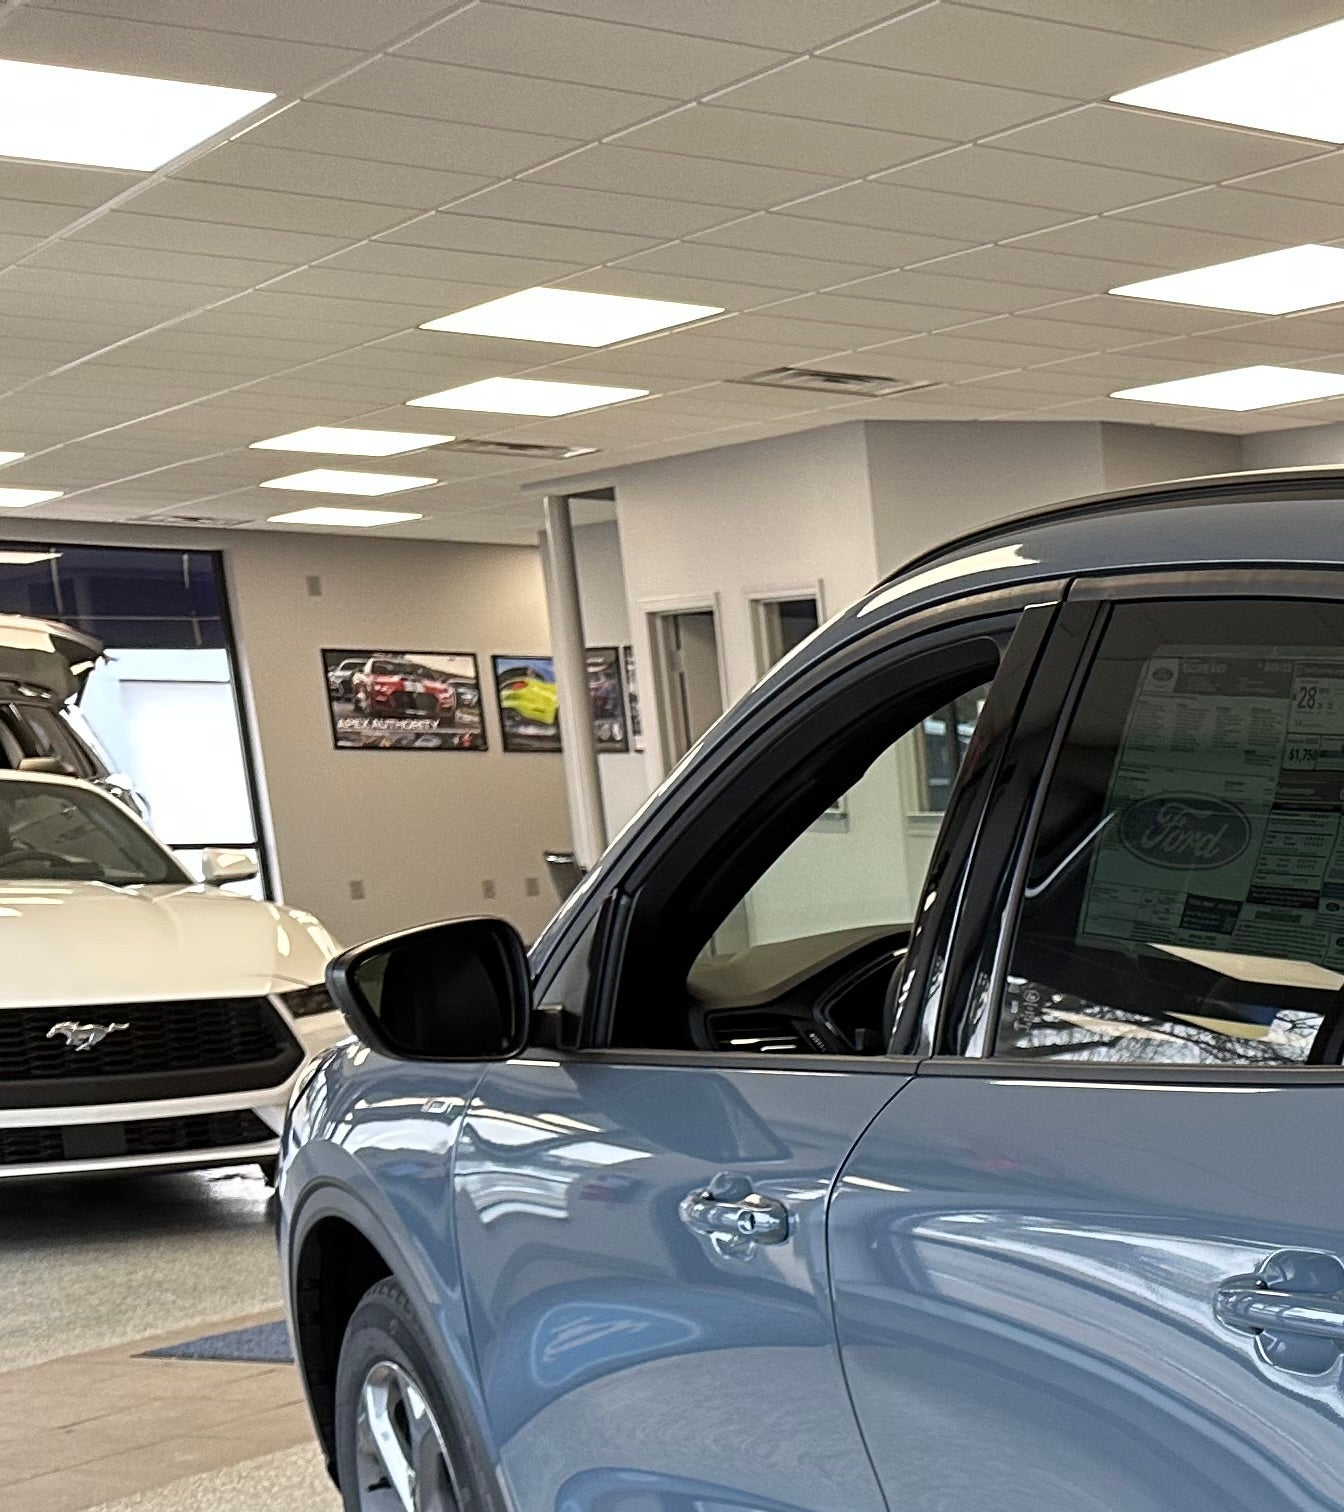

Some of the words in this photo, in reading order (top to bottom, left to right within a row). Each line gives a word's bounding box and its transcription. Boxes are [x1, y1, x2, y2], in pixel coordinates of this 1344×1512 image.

[1297, 686, 1317, 709] 28
[337, 718, 369, 730] APEX
[1140, 801, 1229, 858] Ford
